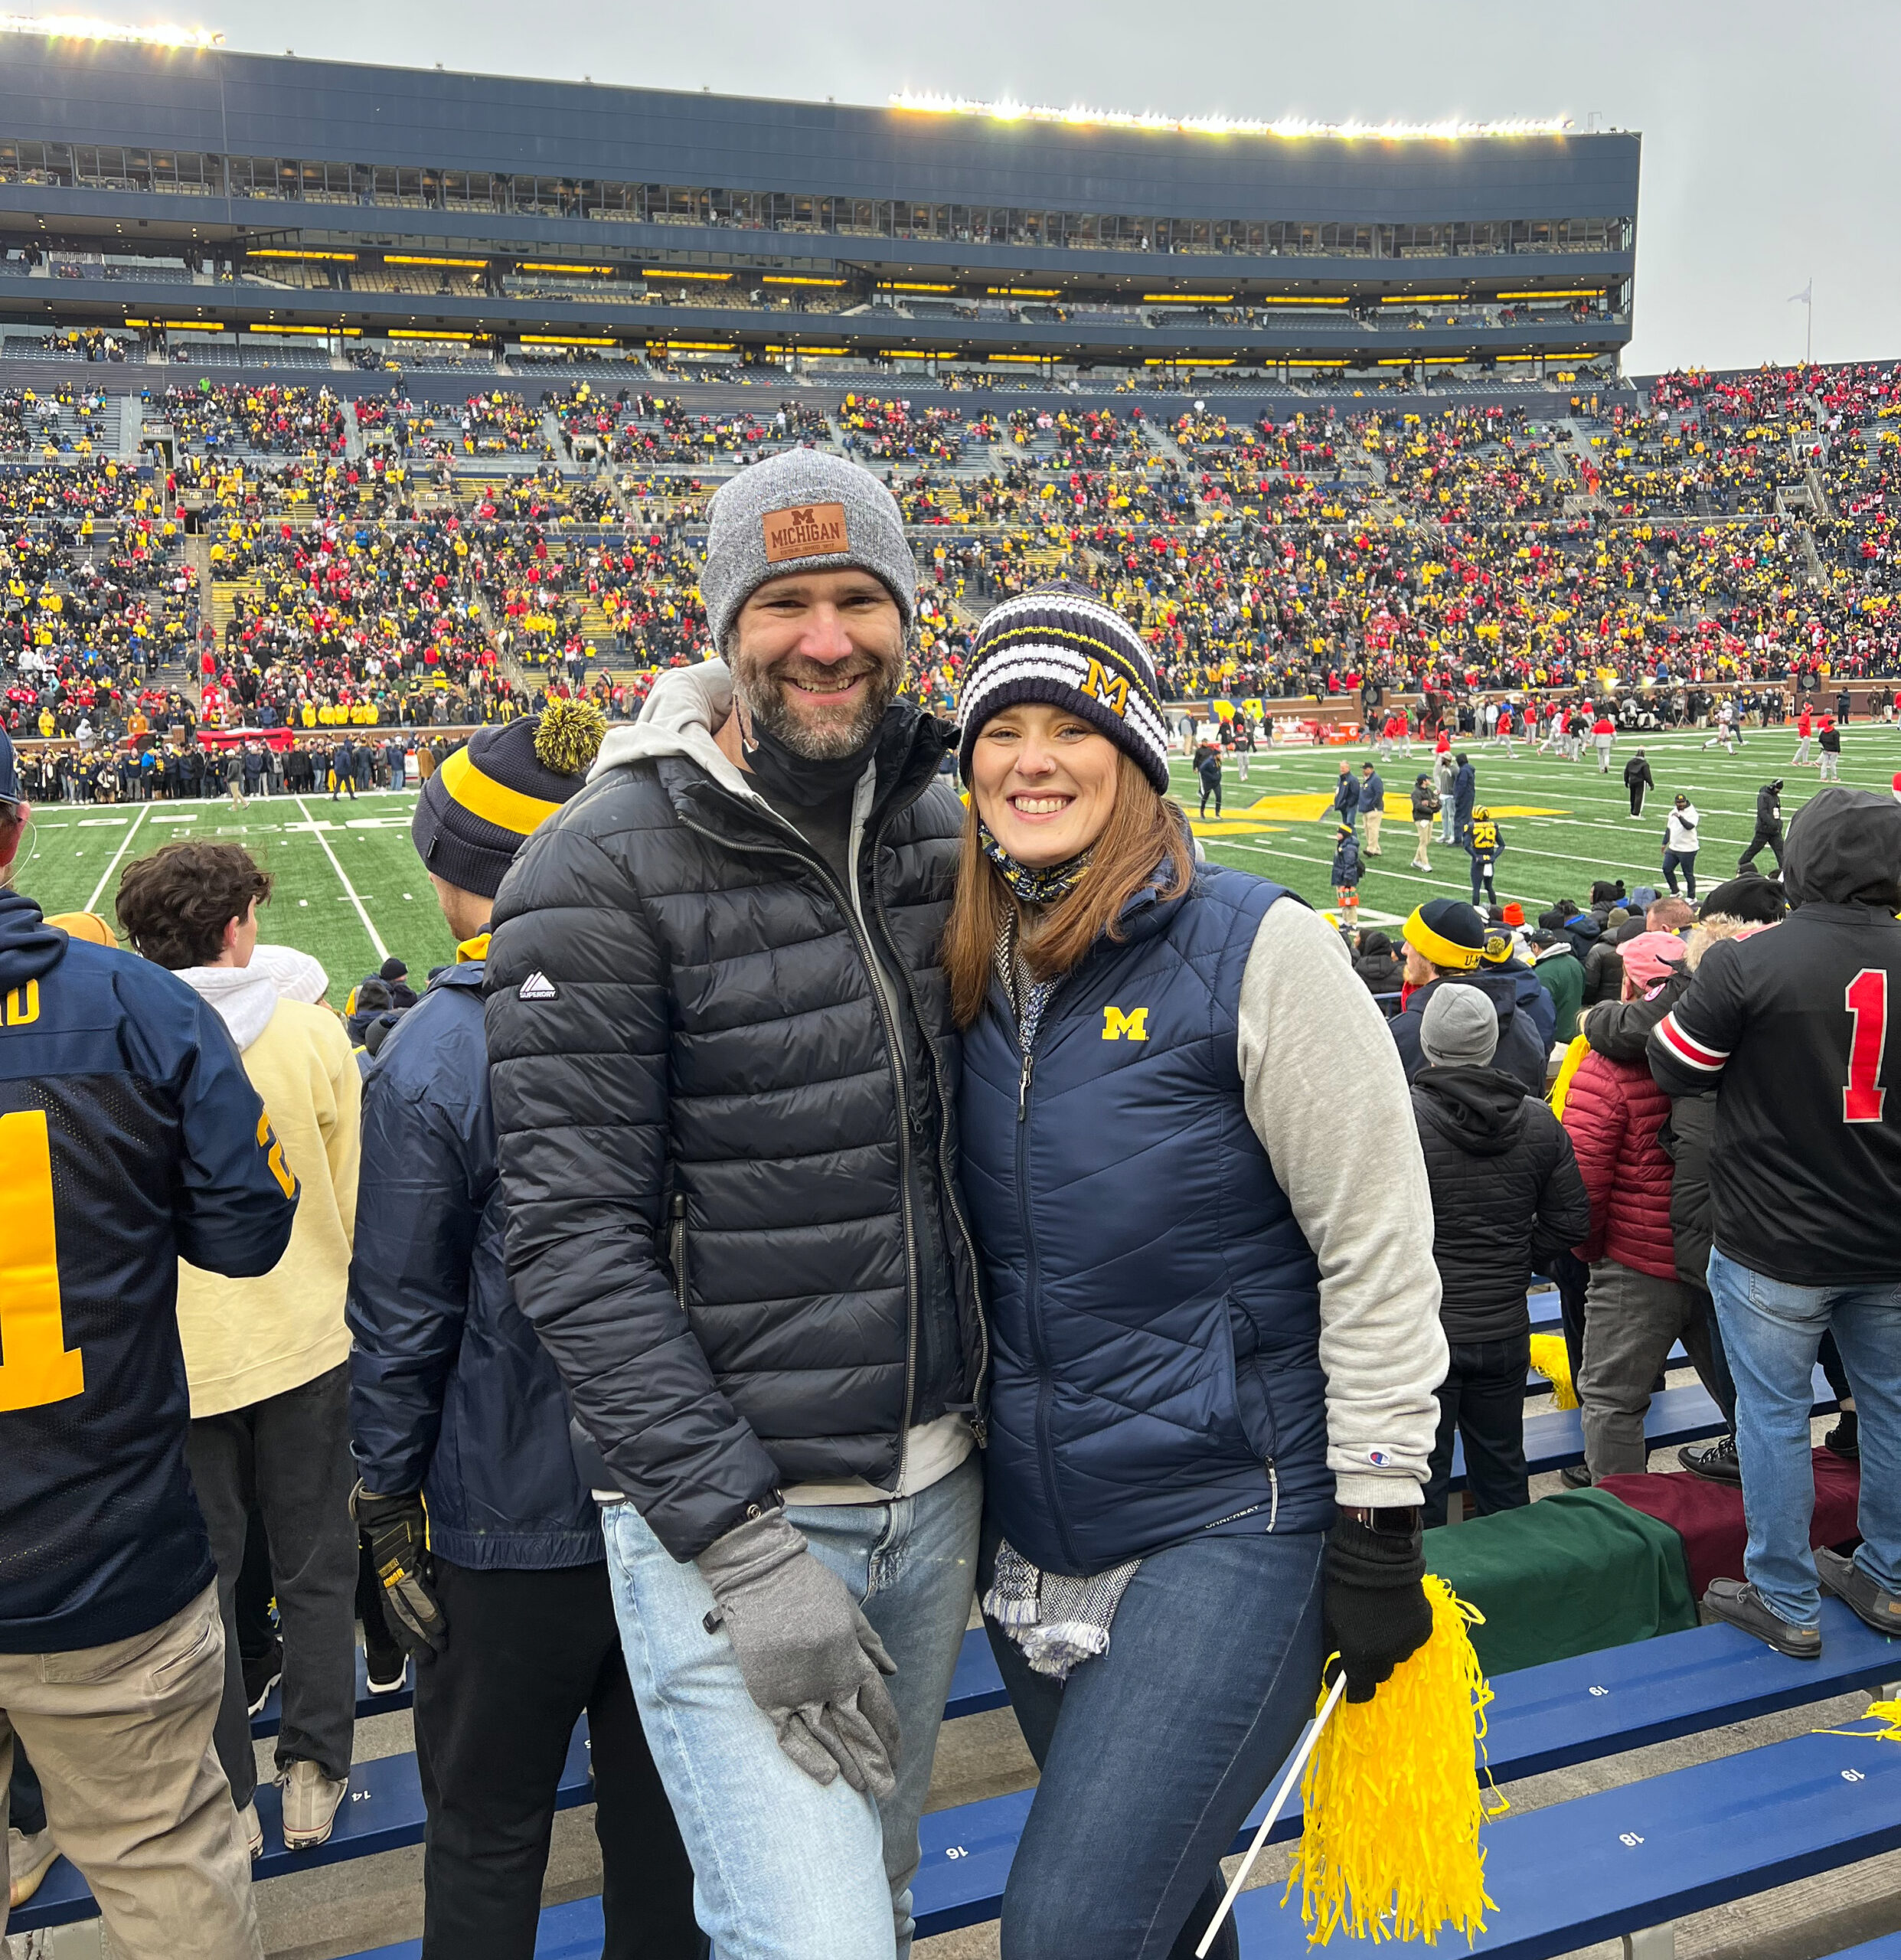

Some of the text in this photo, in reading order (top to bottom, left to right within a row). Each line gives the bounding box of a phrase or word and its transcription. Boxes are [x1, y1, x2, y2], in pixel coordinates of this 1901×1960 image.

[791, 508, 815, 526] M
[771, 522, 841, 548] MICHIGAN
[1080, 655, 1130, 718] M
[1472, 827, 1496, 848] 29
[519, 990, 557, 998] SUPERDRY
[1102, 1005, 1149, 1040] M
[1843, 968, 1887, 1122] 1
[256, 1108, 296, 1200] 2
[1589, 1685, 1609, 1696] 19
[1841, 1769, 1865, 1782] 19
[351, 1790, 371, 1802] 14
[1618, 1831, 1645, 1847] 18
[946, 1846, 968, 1860] 16
